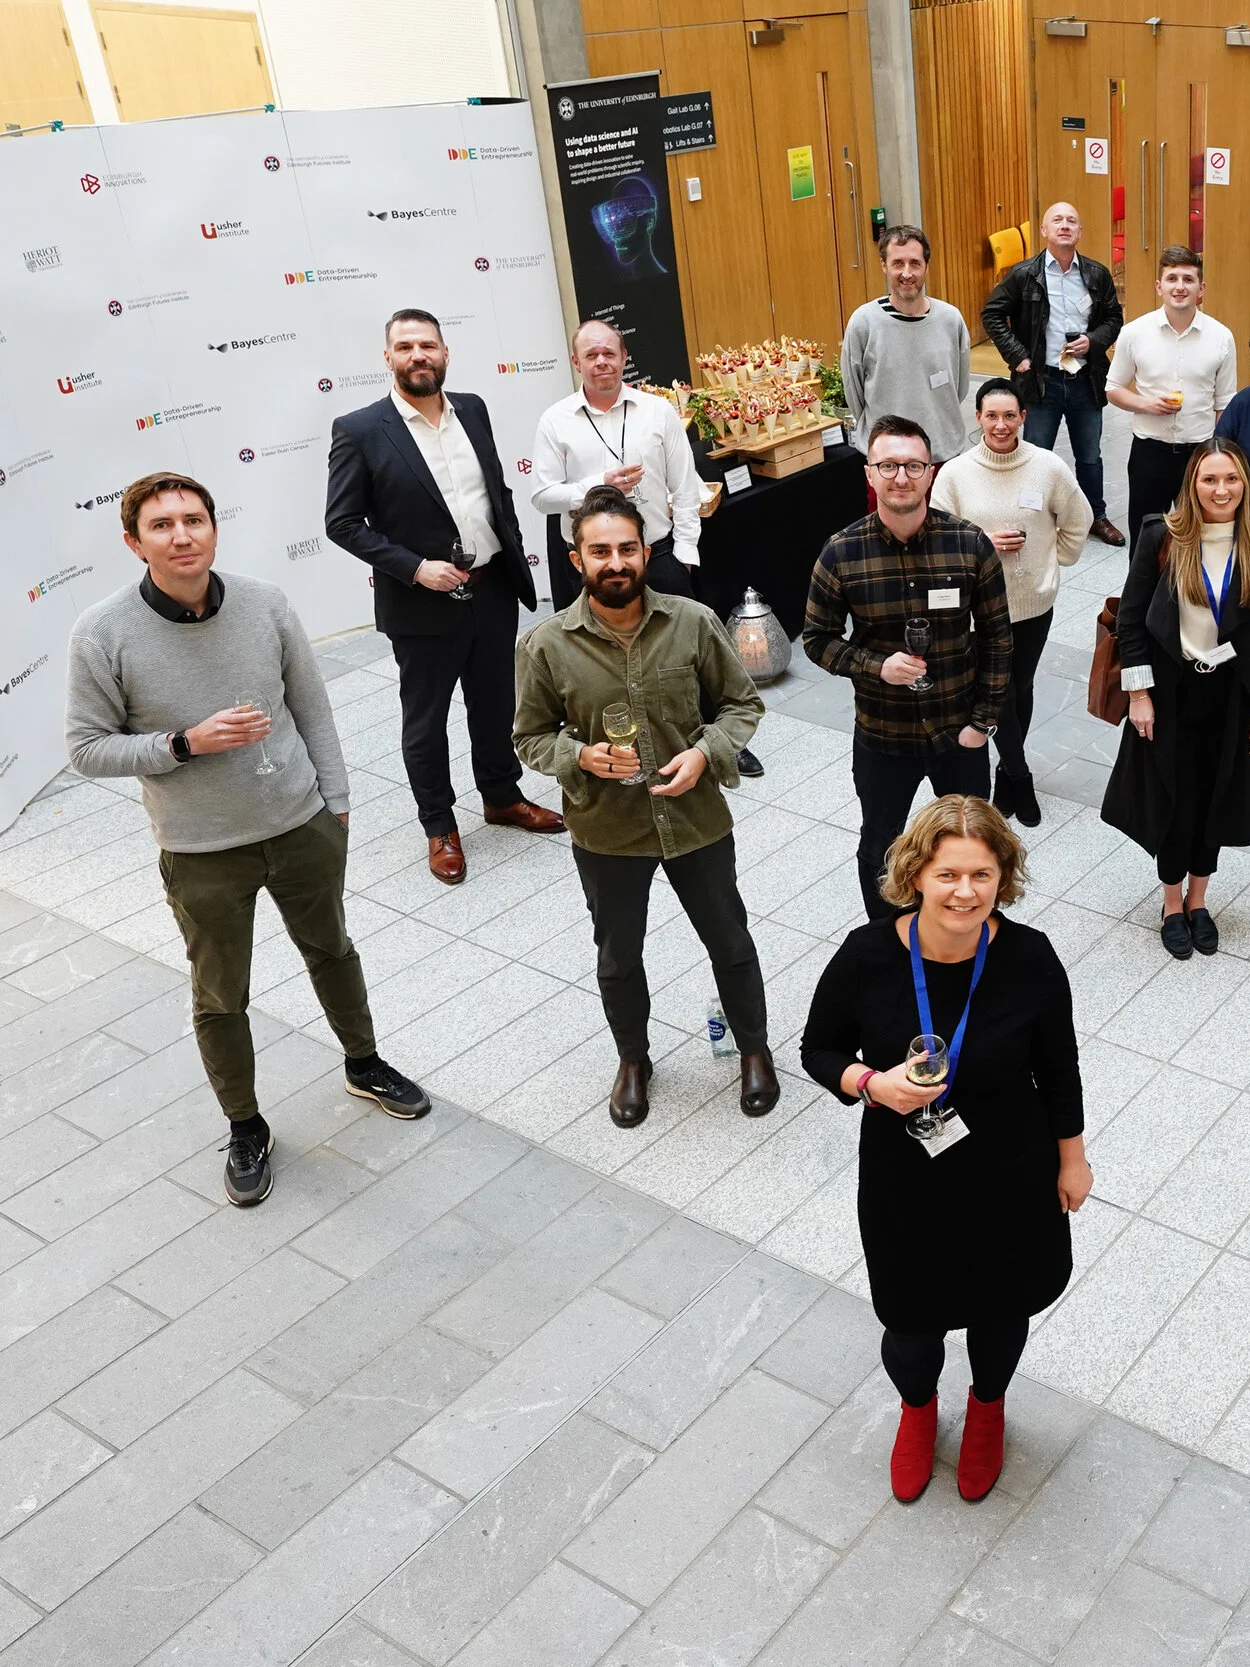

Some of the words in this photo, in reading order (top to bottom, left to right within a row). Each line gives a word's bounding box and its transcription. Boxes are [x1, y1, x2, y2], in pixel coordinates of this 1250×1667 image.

[590, 97, 622, 108] UNIVERSITY
[626, 92, 656, 103] EDINBURGH
[662, 126, 681, 134] obotics
[691, 121, 703, 130] G.07
[565, 137, 583, 146] Using
[583, 134, 597, 143] data
[598, 131, 620, 141] science
[620, 127, 631, 137] and
[567, 150, 574, 158] to
[574, 147, 592, 157] shape
[598, 144, 617, 152] better
[617, 139, 635, 149] future
[481, 151, 533, 160] Entrepreneurship
[105, 178, 146, 188] INNOVATIONS
[391, 208, 457, 220] BayesCentre
[217, 221, 242, 230] usher
[219, 230, 249, 238] institute
[23, 246, 57, 260] HERIOT
[509, 254, 546, 263] UNIVERSITY
[36, 254, 61, 266] WATT
[502, 261, 541, 269] EDINBURGH
[317, 267, 359, 275] Data-Driven
[318, 273, 377, 282] Entrepreneurship
[621, 328, 636, 336] Science
[231, 332, 297, 349] BayesCentre
[72, 372, 95, 384] usher
[351, 372, 393, 381] UNIVERSITY
[74, 379, 103, 391] institute
[163, 402, 204, 416] Data-Driven
[165, 405, 222, 423] Entrepreneurship
[286, 537, 320, 552] HERIOT
[297, 544, 321, 556] WATT
[46, 565, 77, 584] Data-Driven
[48, 566, 93, 590] Entrepreneurship
[11, 654, 48, 688] BayesCentre
